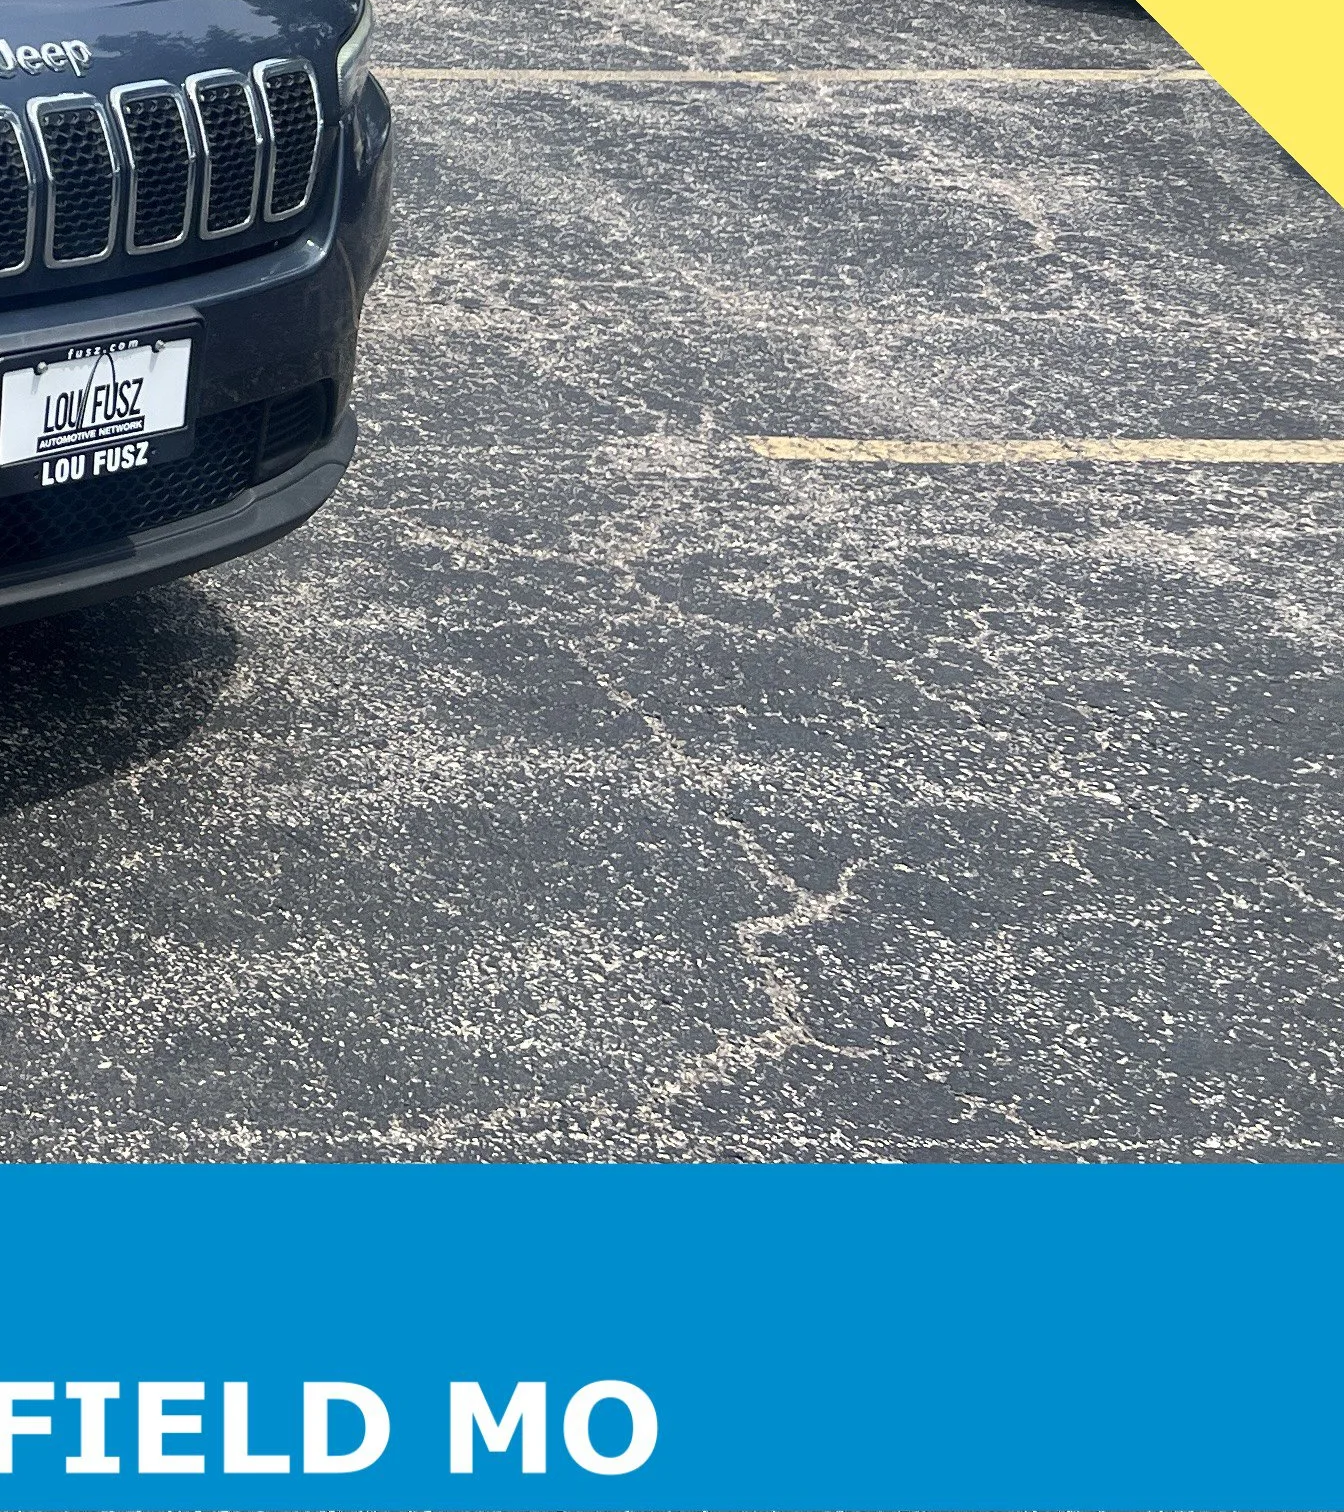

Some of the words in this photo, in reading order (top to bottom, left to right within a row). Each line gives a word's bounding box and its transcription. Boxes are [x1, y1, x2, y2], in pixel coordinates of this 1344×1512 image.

[67, 339, 139, 360] fusz.com
[43, 389, 83, 433] LOU
[91, 377, 144, 424] FUSZ
[39, 429, 97, 450] AUTOMOTIVE
[98, 420, 143, 437] NETWORK
[41, 454, 86, 487] LOU
[93, 441, 149, 476] FUSZ
